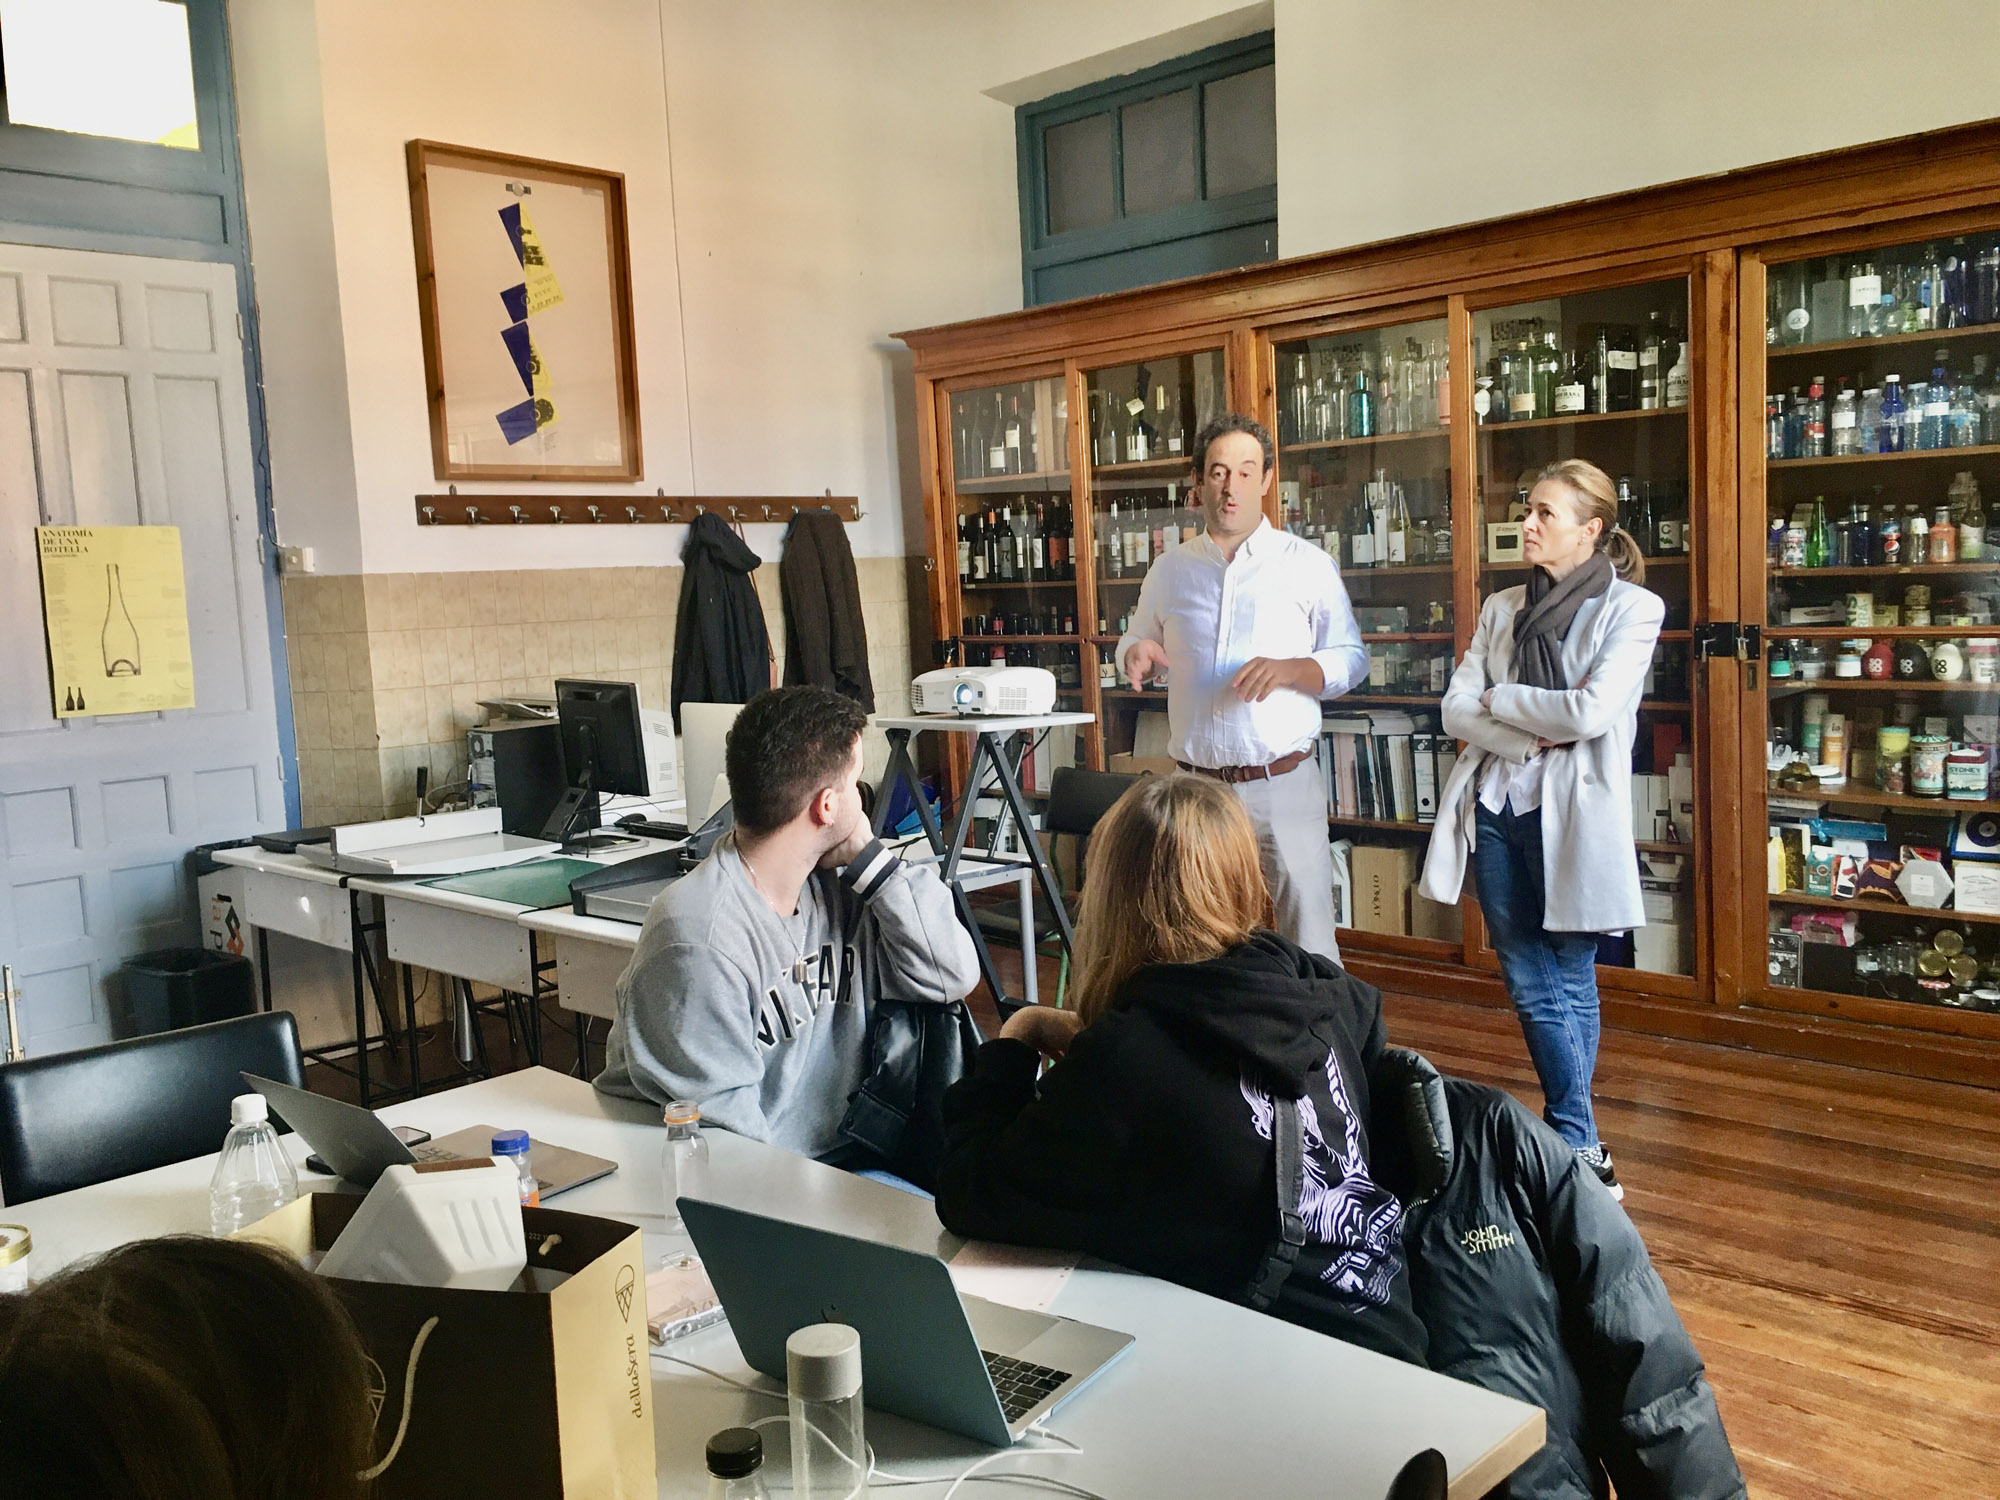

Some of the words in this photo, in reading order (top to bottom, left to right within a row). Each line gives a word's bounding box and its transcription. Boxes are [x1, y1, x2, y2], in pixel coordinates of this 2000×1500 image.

[43, 529, 94, 537] ANATOMÍA
[1461, 1224, 1500, 1244] JOHN
[1469, 1232, 1515, 1254] SMITH
[626, 1334, 643, 1419] dellaSera
